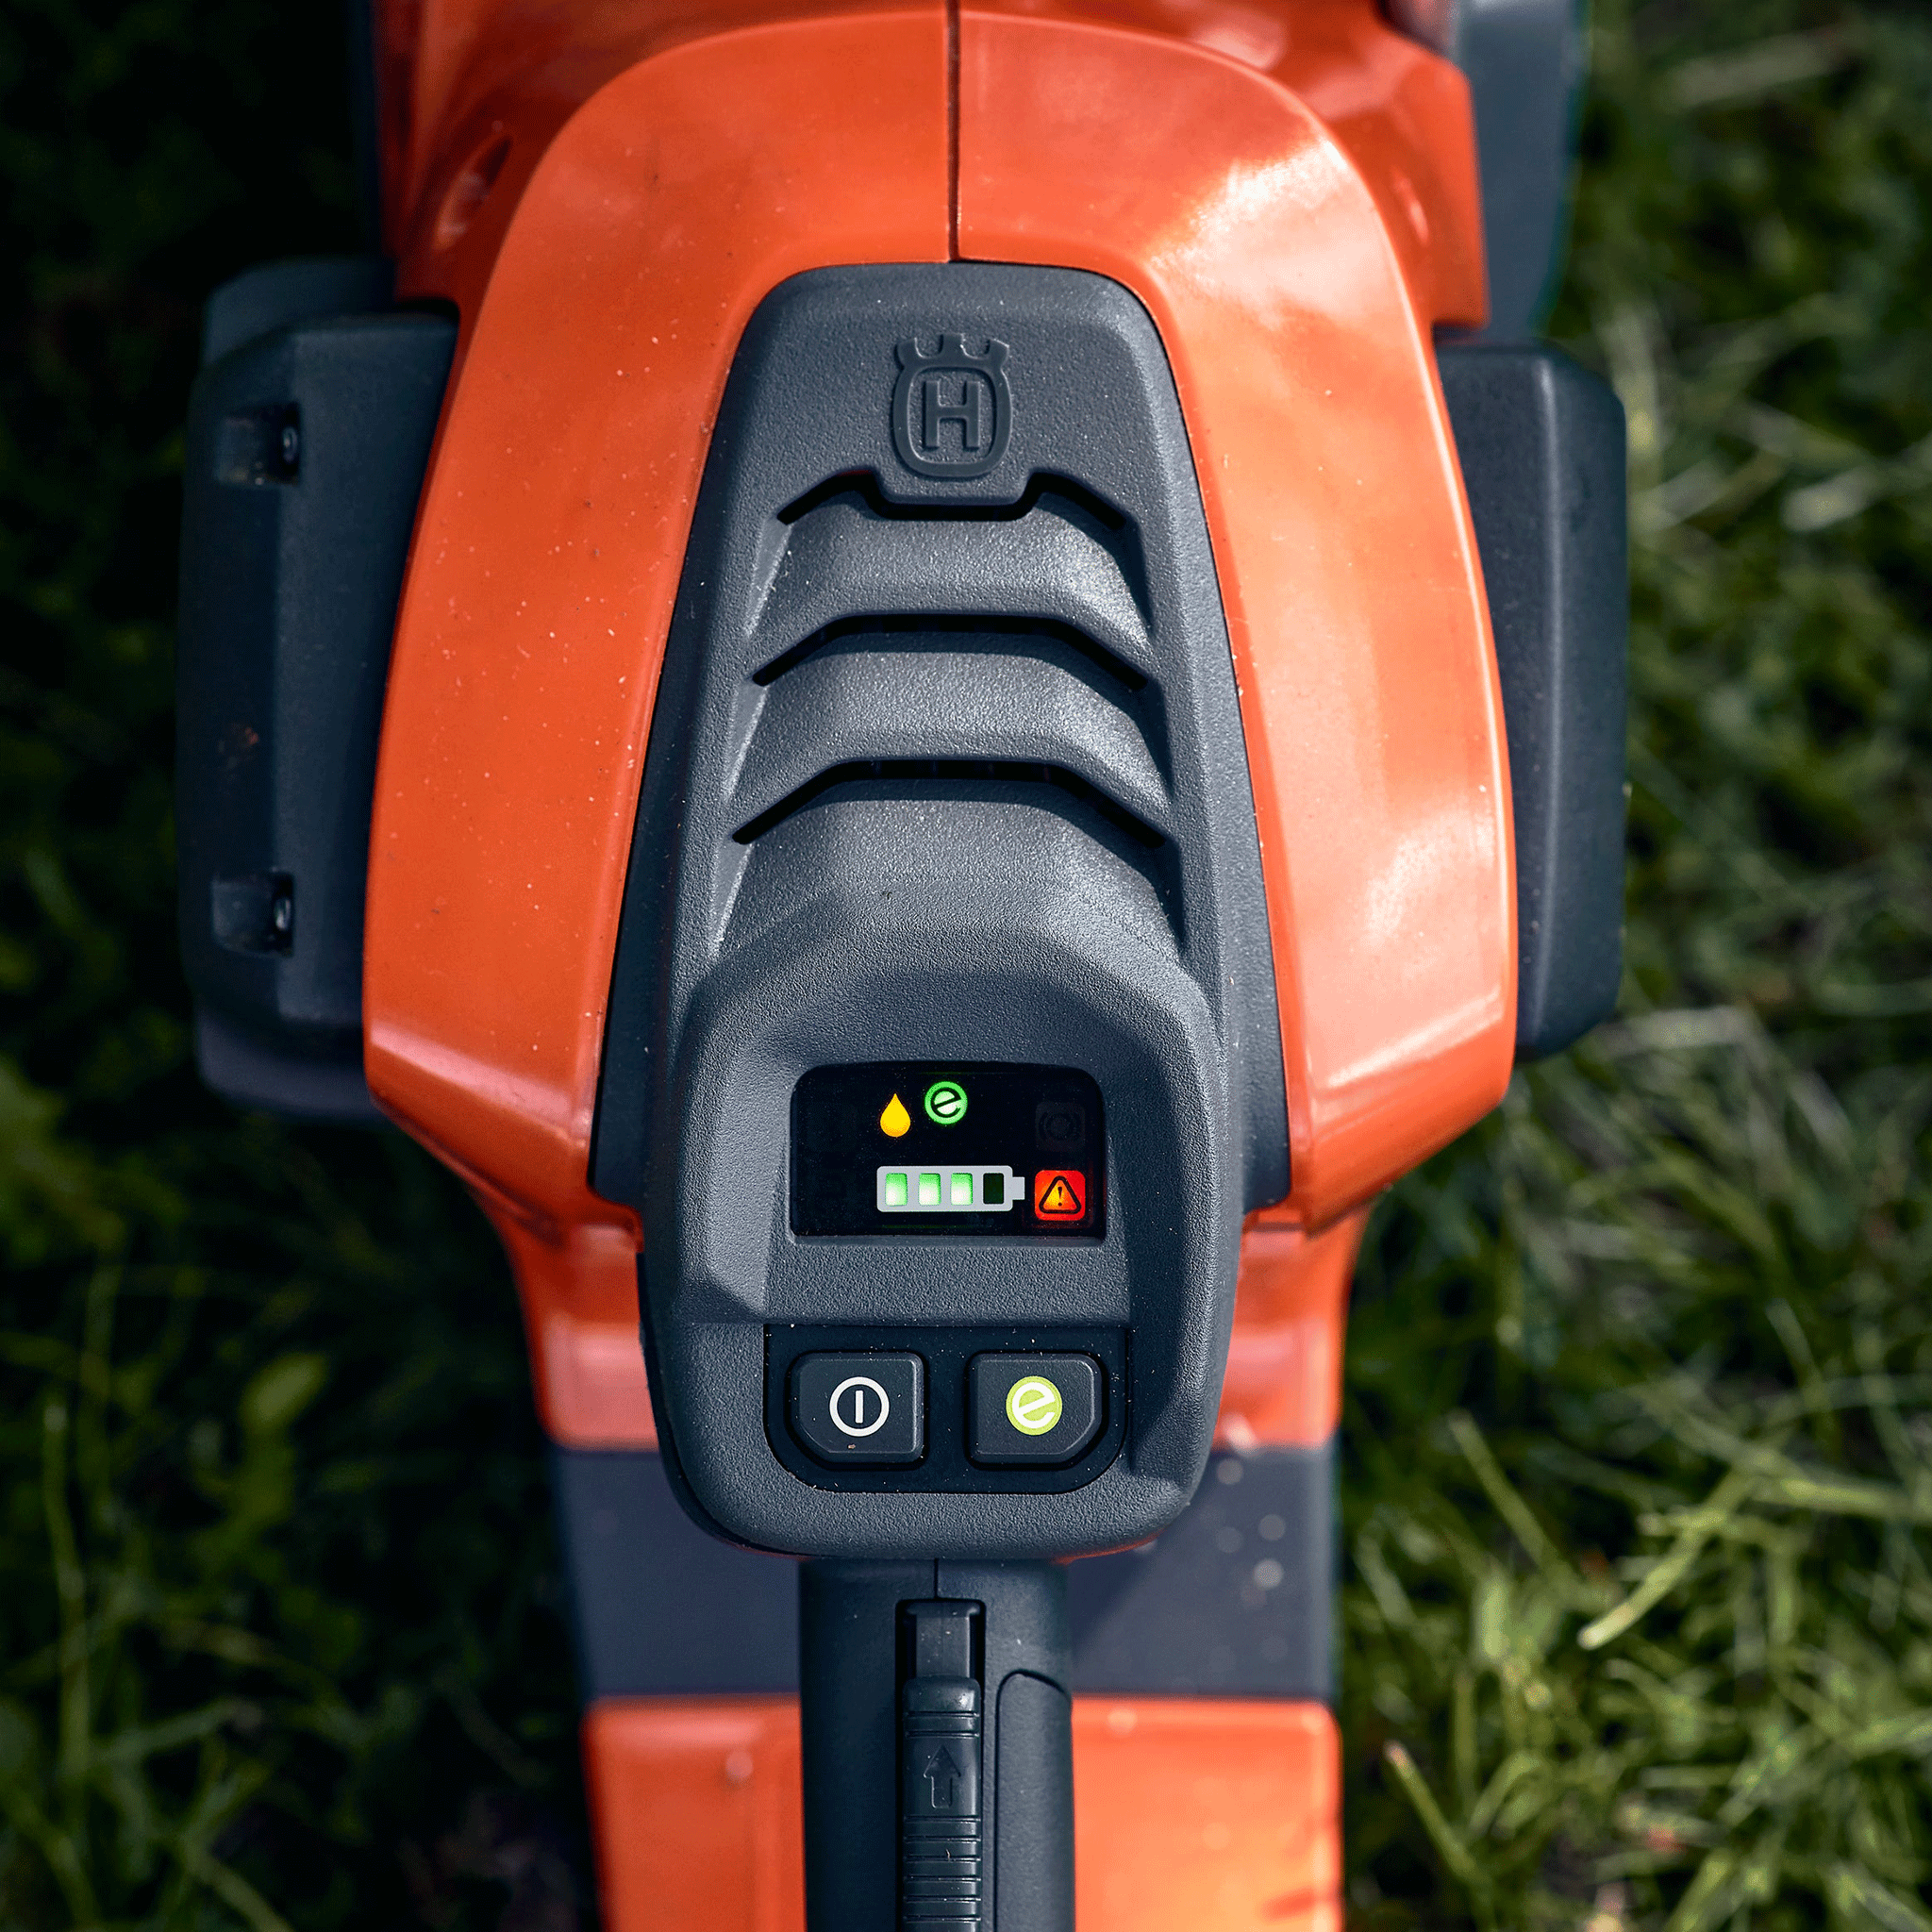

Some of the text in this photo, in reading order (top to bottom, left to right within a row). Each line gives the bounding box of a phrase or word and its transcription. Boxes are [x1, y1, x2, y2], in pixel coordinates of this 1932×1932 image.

[924, 380, 980, 449] H
[931, 1086, 962, 1118] e
[1011, 1381, 1056, 1429] e
